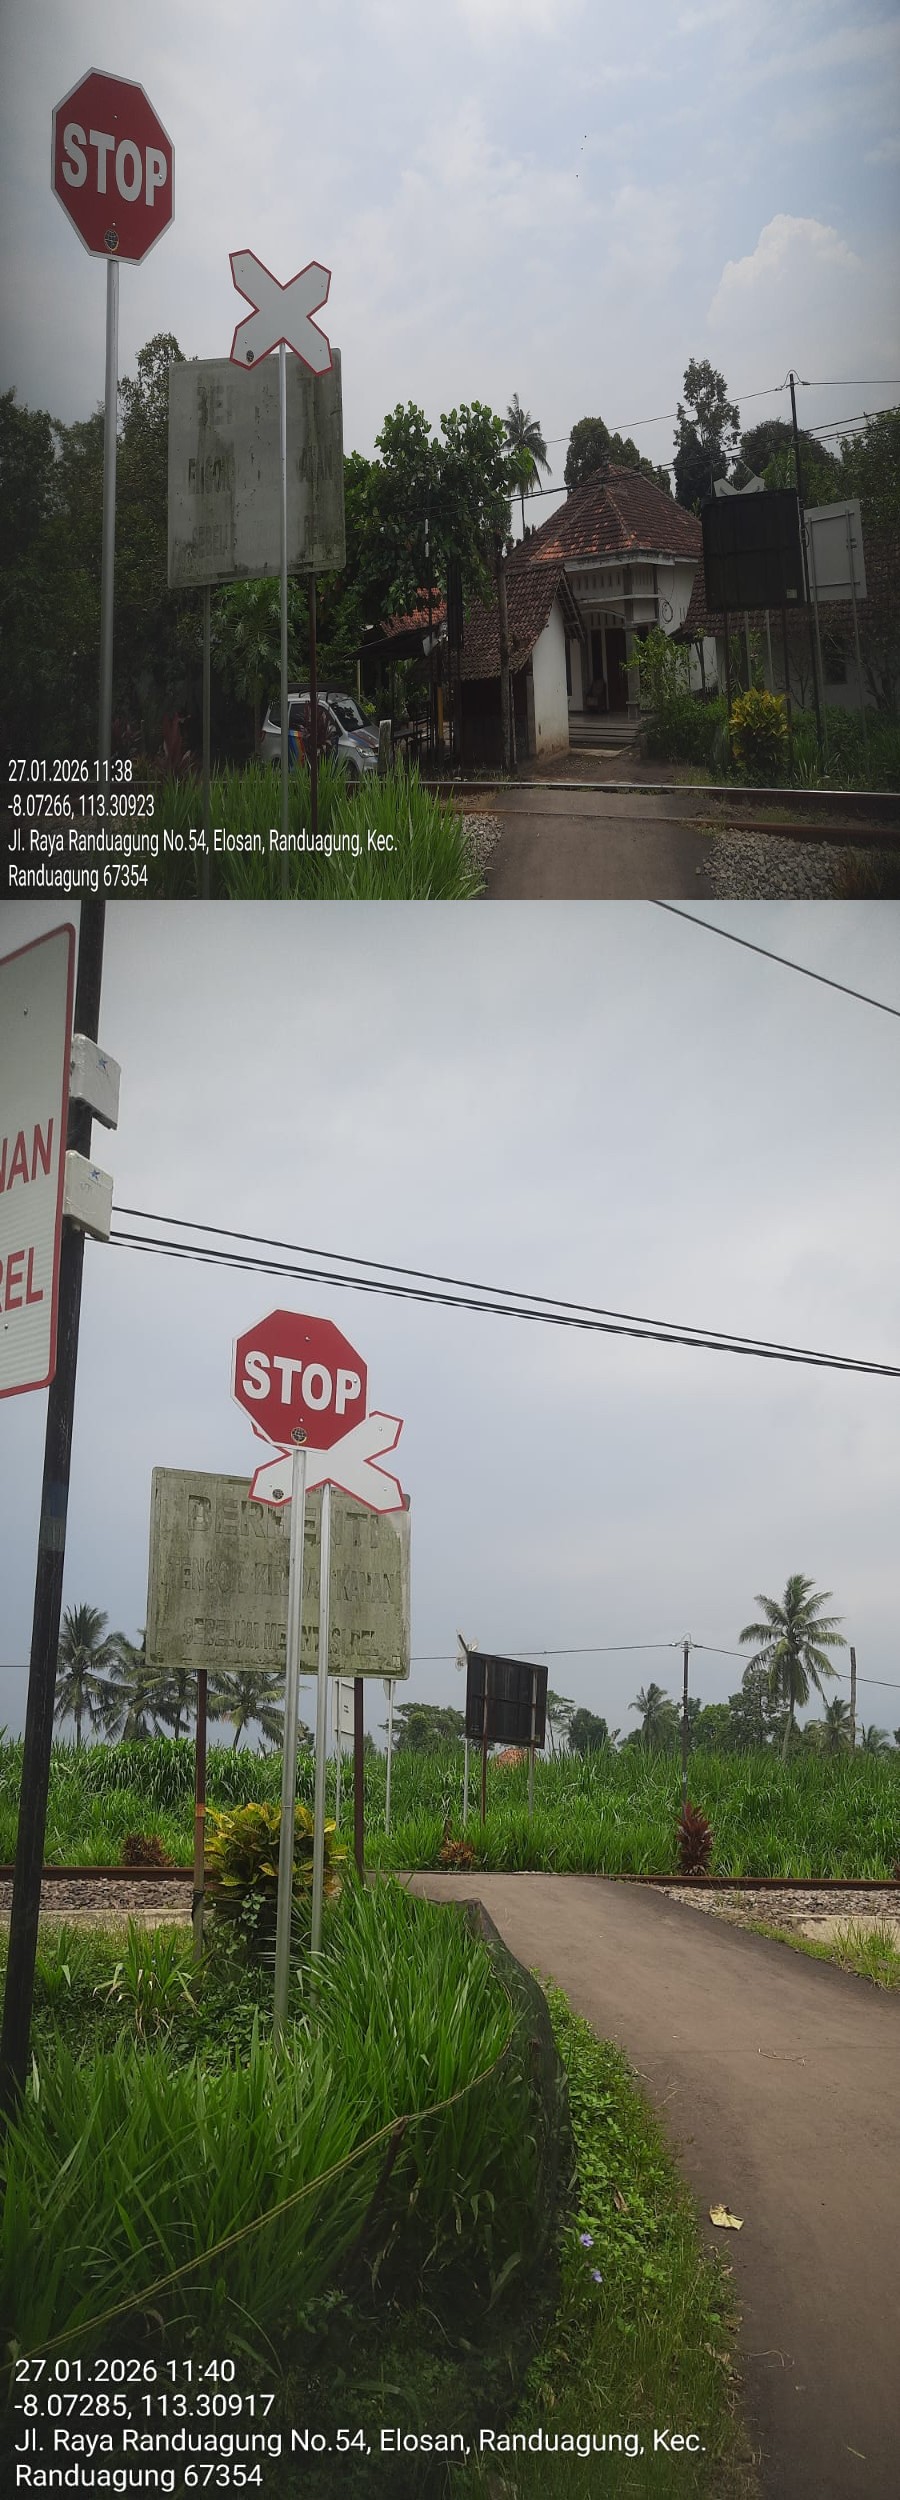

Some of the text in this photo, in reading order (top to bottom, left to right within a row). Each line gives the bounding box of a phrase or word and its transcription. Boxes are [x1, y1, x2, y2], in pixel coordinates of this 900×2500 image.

[62, 122, 167, 207] STOP
[0, 1246, 43, 1313] EL
[242, 1351, 361, 1415] STOP
